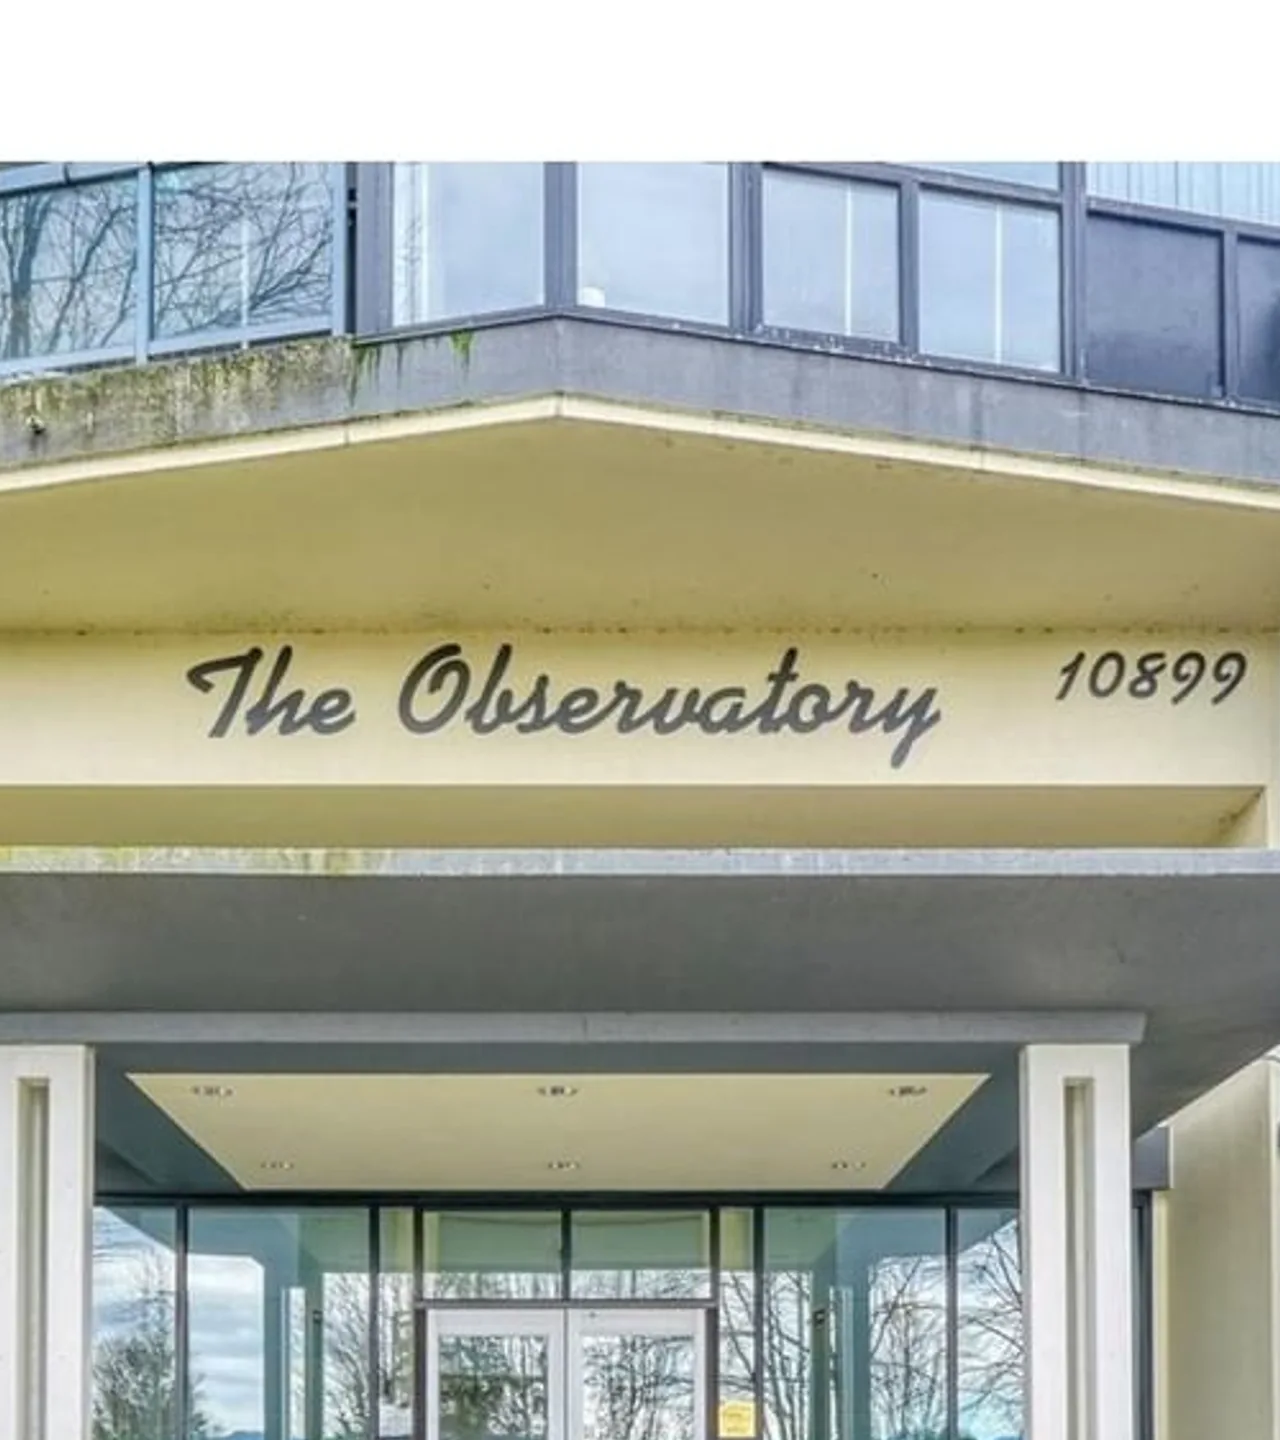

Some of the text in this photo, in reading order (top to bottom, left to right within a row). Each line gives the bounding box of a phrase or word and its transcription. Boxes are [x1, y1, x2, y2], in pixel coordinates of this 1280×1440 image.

[187, 642, 942, 768] The Observatory
[1054, 650, 1246, 706] 10899
